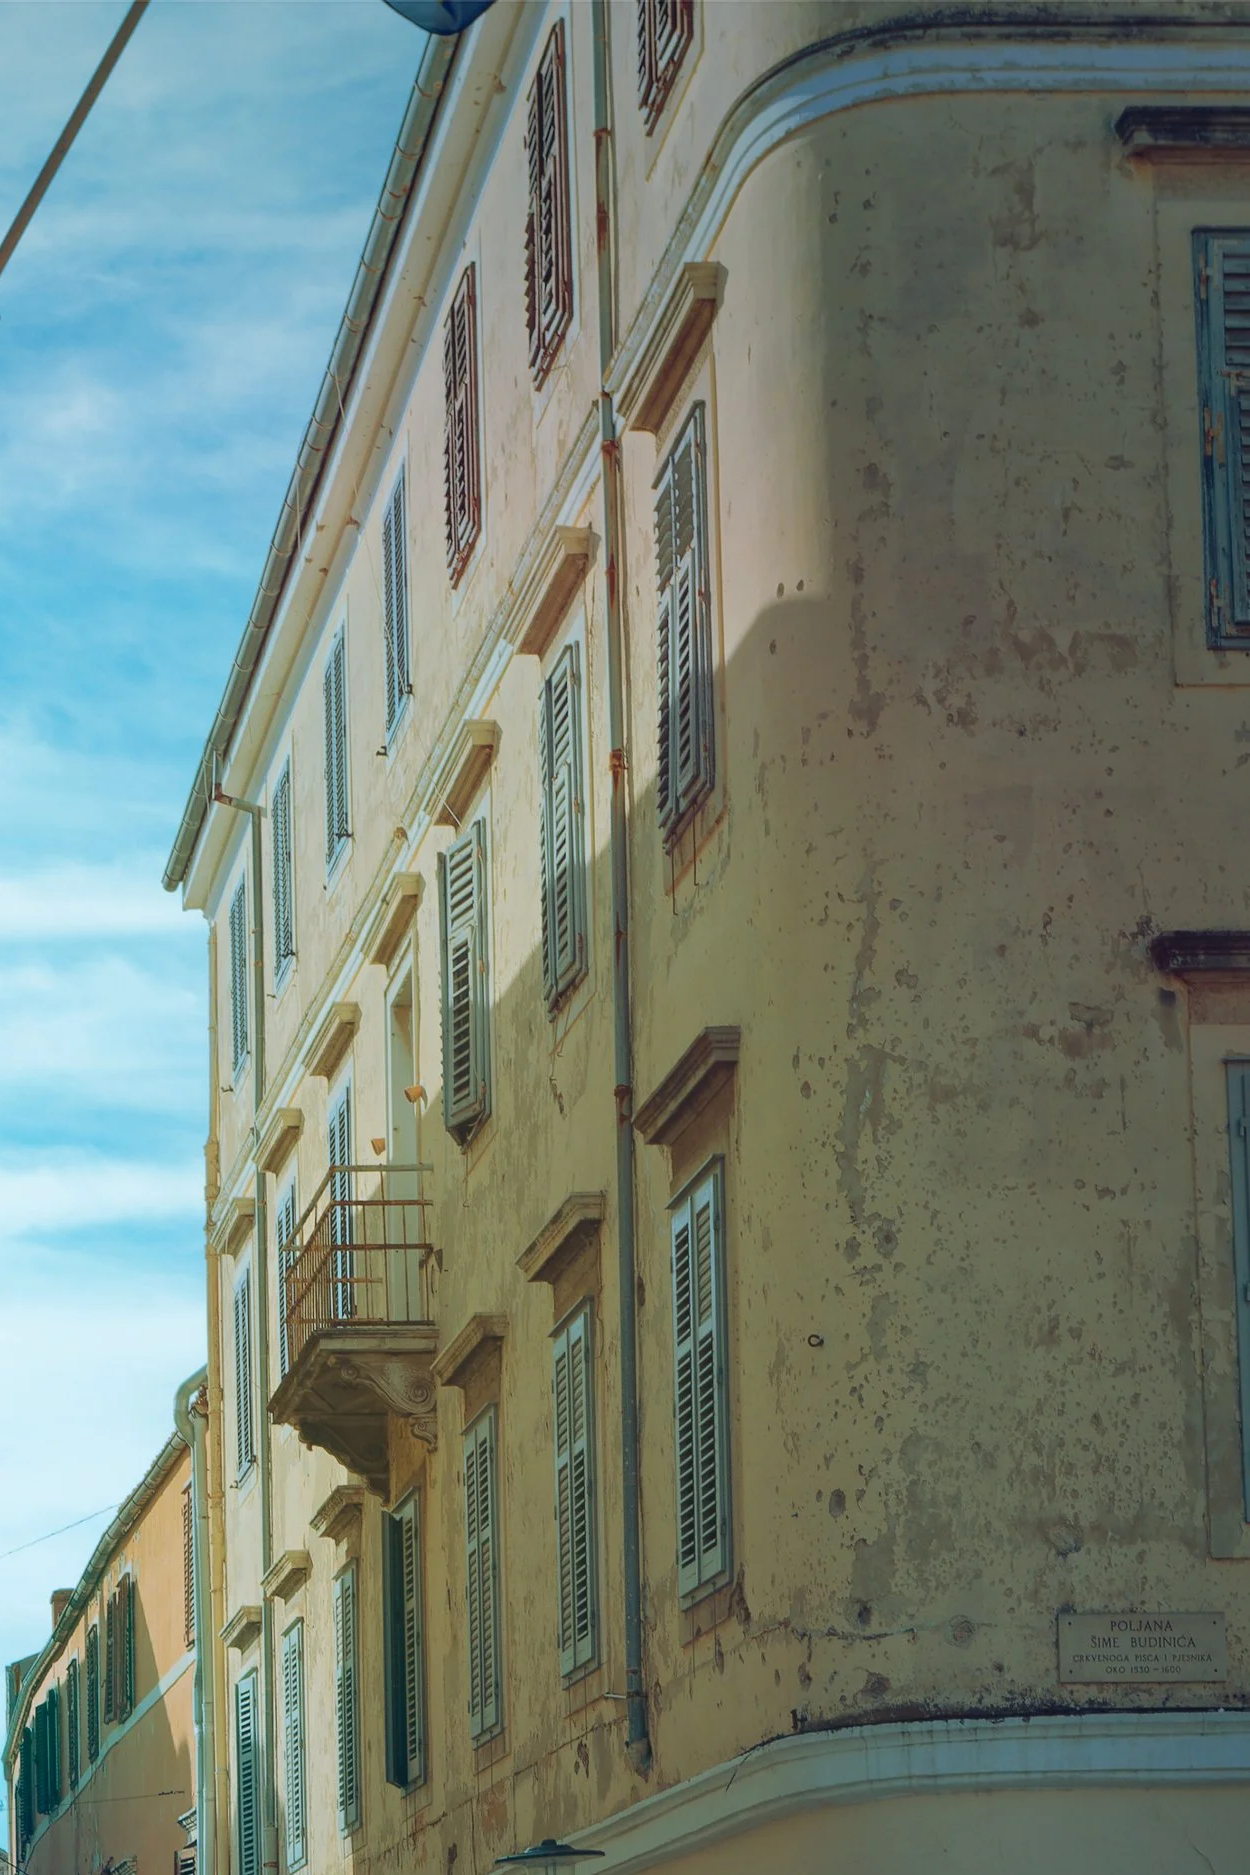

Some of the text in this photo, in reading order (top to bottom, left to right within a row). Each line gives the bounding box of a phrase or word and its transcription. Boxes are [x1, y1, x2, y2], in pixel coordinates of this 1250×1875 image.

[1110, 1620, 1173, 1632] POLJANA
[1091, 1635, 1196, 1648] ŠIME BUDINIĆA
[1072, 1654, 1130, 1662] CRKVENOGA
[1134, 1654, 1160, 1662] PISCA
[1172, 1654, 1213, 1662] PJESNIKA
[1105, 1666, 1126, 1674] OKO
[1161, 1666, 1182, 1674] 1600
